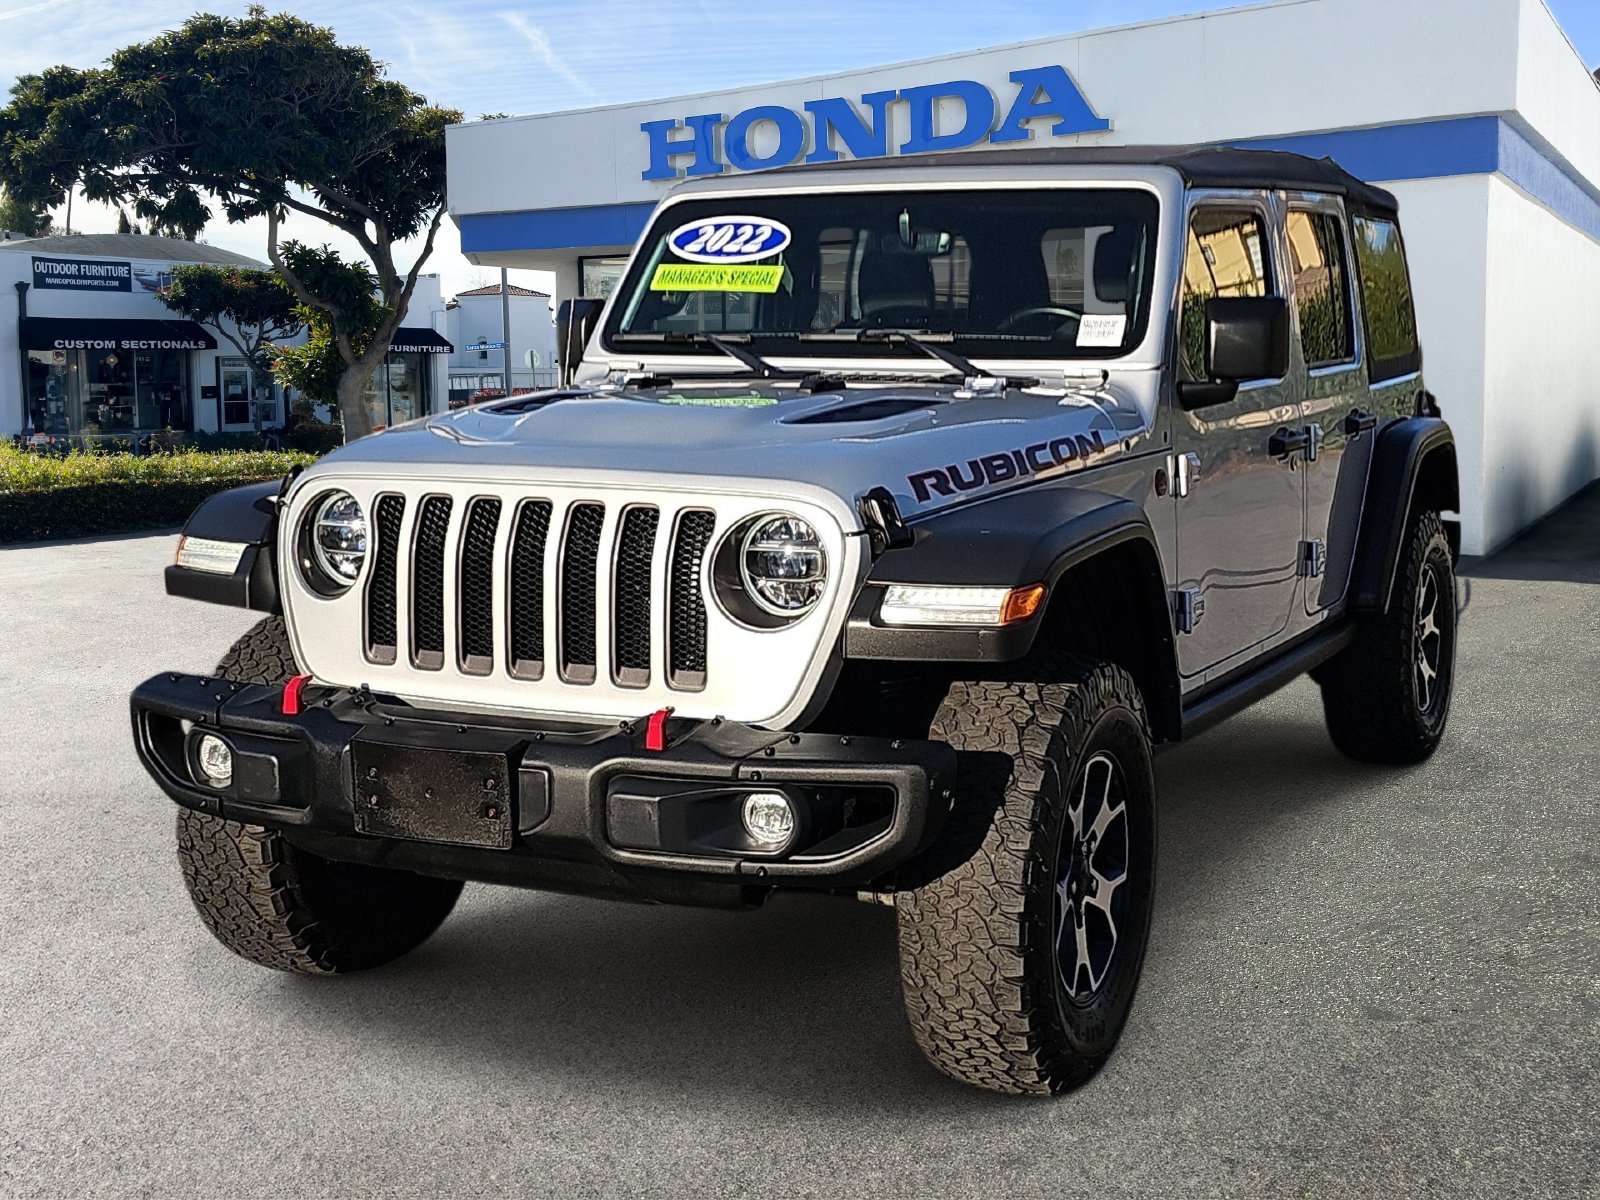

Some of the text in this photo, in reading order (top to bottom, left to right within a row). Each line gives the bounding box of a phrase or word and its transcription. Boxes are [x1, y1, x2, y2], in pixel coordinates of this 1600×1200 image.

[641, 64, 1112, 181] HONDA
[683, 224, 773, 253] 2022
[34, 261, 130, 278] OUTDOOR FURNITURE
[657, 269, 776, 286] MANAGER'S SPECIAL
[45, 277, 119, 287] MARCOPOLOIMPORTS.COM
[54, 339, 206, 349] CUSTOM SECTIONALS
[388, 344, 450, 353] FURNITURE
[907, 430, 1105, 503] RUBICON
